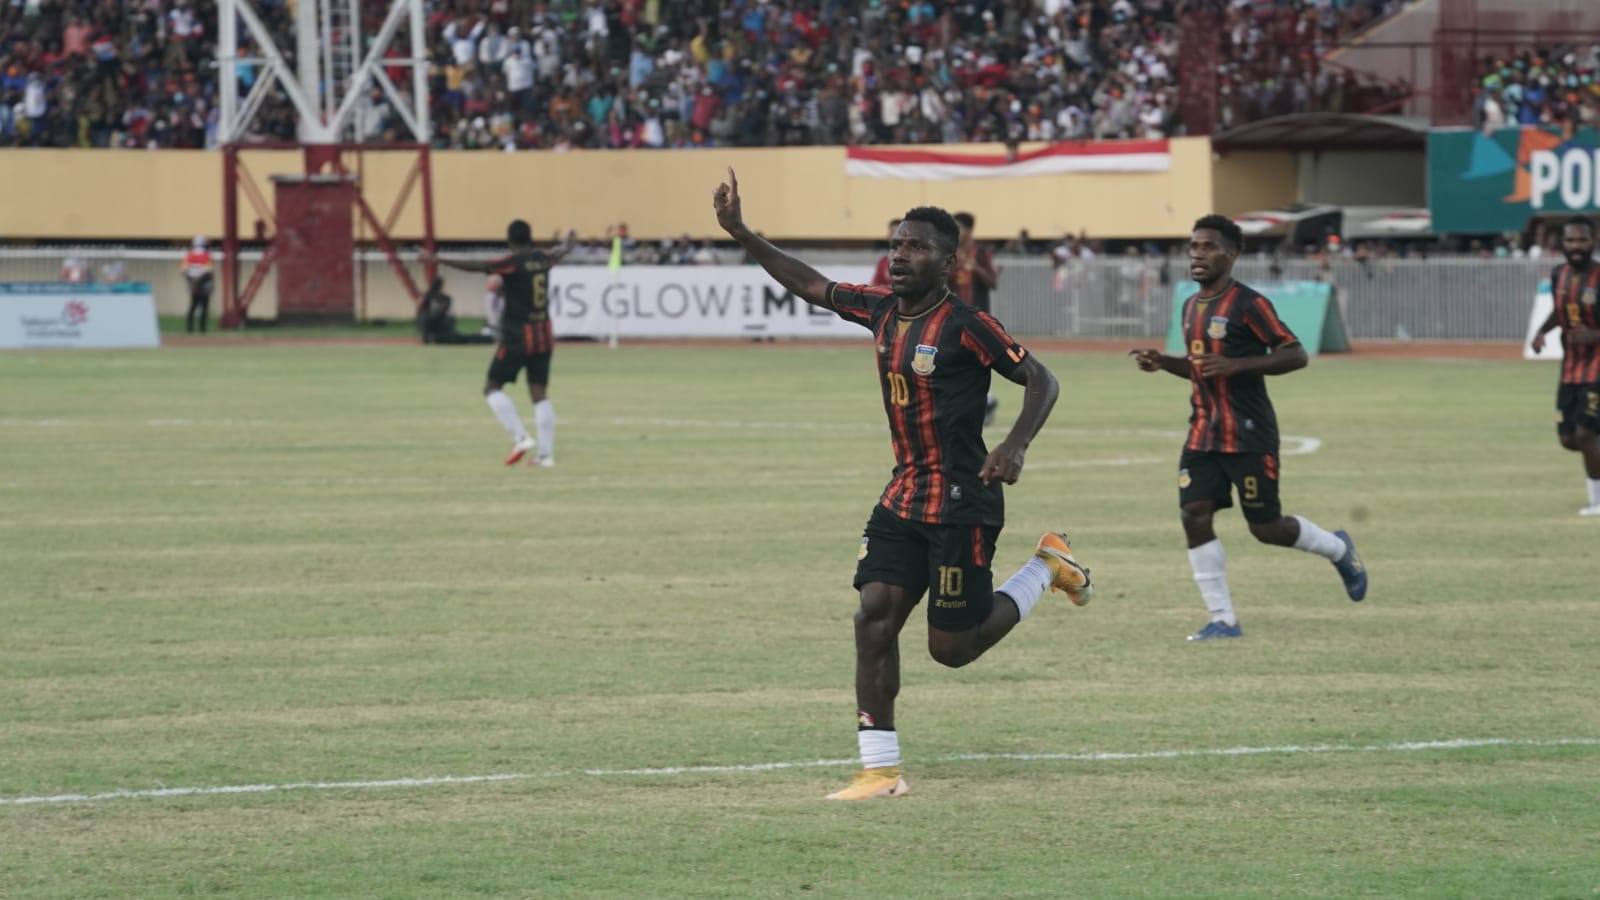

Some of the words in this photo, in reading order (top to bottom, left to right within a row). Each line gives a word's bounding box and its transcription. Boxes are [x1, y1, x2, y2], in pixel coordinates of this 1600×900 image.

[532, 273, 546, 309] 6
[602, 283, 733, 319] GLOW
[886, 371, 909, 407] 10
[1244, 475, 1257, 499] 9
[938, 565, 962, 597] 10
